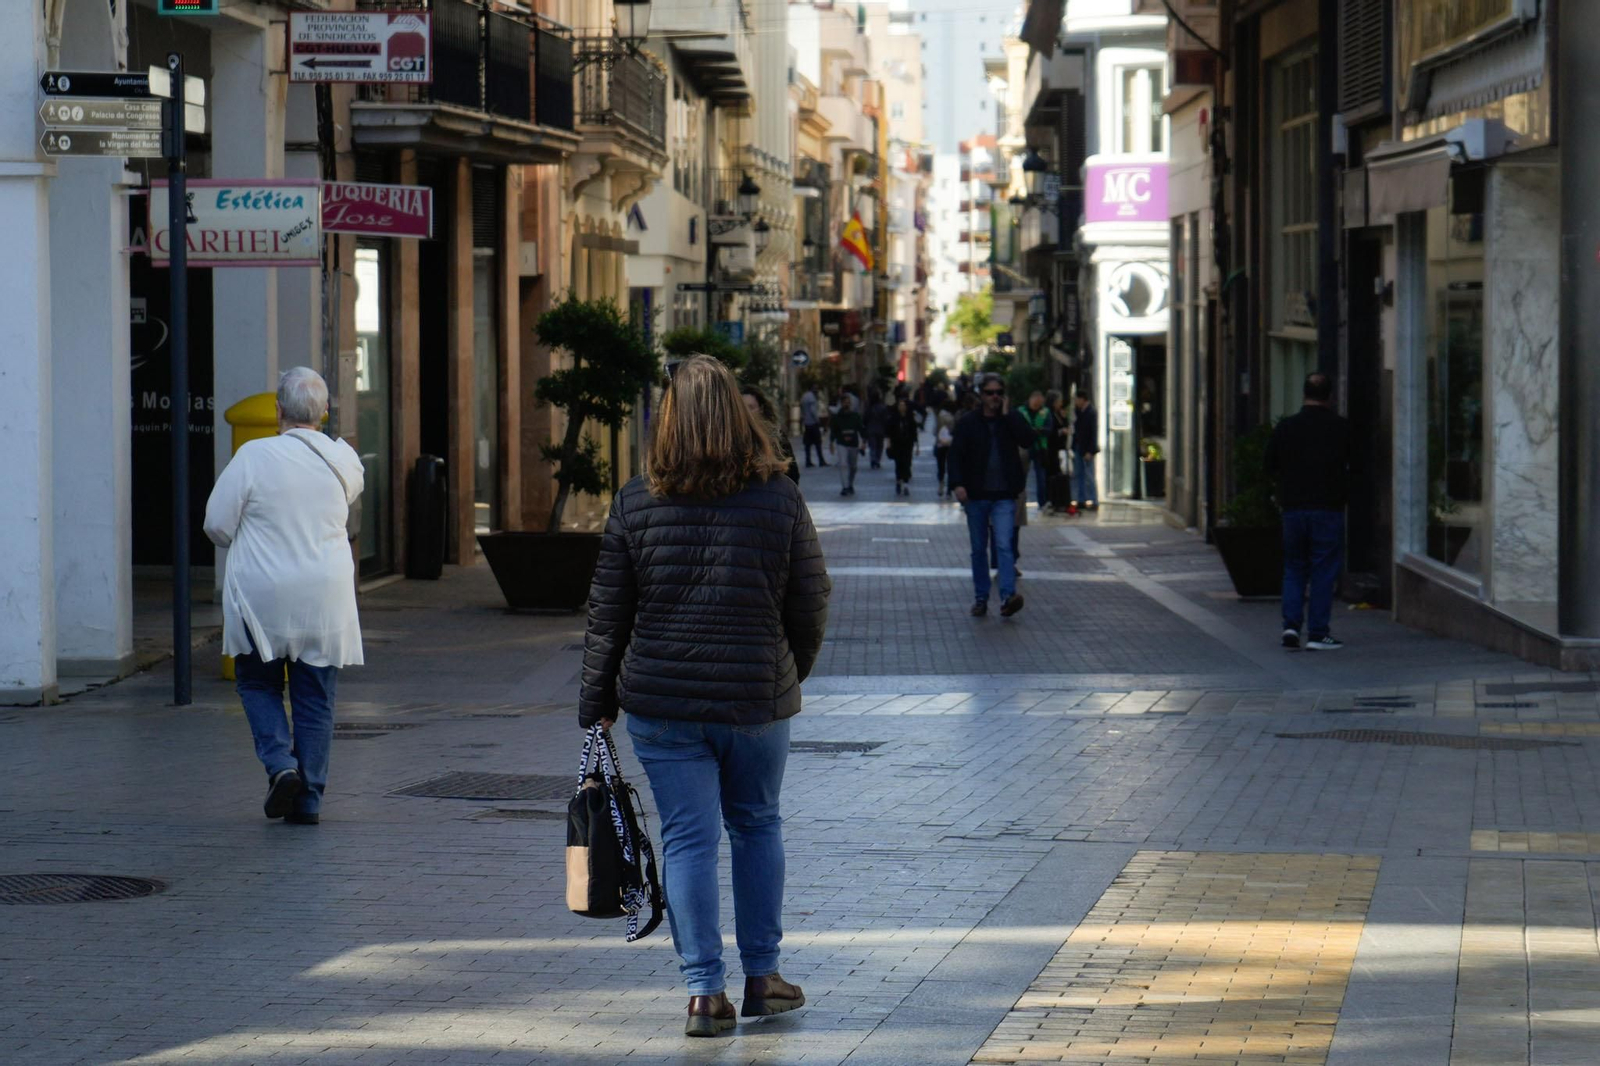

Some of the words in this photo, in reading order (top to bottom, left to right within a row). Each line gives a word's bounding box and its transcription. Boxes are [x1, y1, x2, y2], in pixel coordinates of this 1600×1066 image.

[307, 24, 368, 32] PROVINCIAL
[298, 32, 311, 41] DE
[315, 32, 377, 41] SINDICATOS
[389, 56, 424, 71] CGT
[308, 72, 322, 80] 959
[324, 72, 334, 80] 25
[335, 72, 345, 80] 01
[347, 72, 355, 80] 21
[362, 72, 377, 81] FAX
[378, 73, 393, 81] 959
[394, 73, 404, 81] 25
[405, 73, 414, 81] 01
[416, 73, 426, 81] 17
[91, 111, 115, 119] Palacio
[126, 112, 160, 121] Congresos
[111, 132, 150, 140] Monumento
[107, 141, 129, 149] Virgen
[1101, 172, 1151, 203] MC
[215, 189, 304, 211] Estética
[280, 216, 314, 244] UNISEX
[155, 228, 290, 254] CARHEL
[142, 391, 214, 413] Mojas
